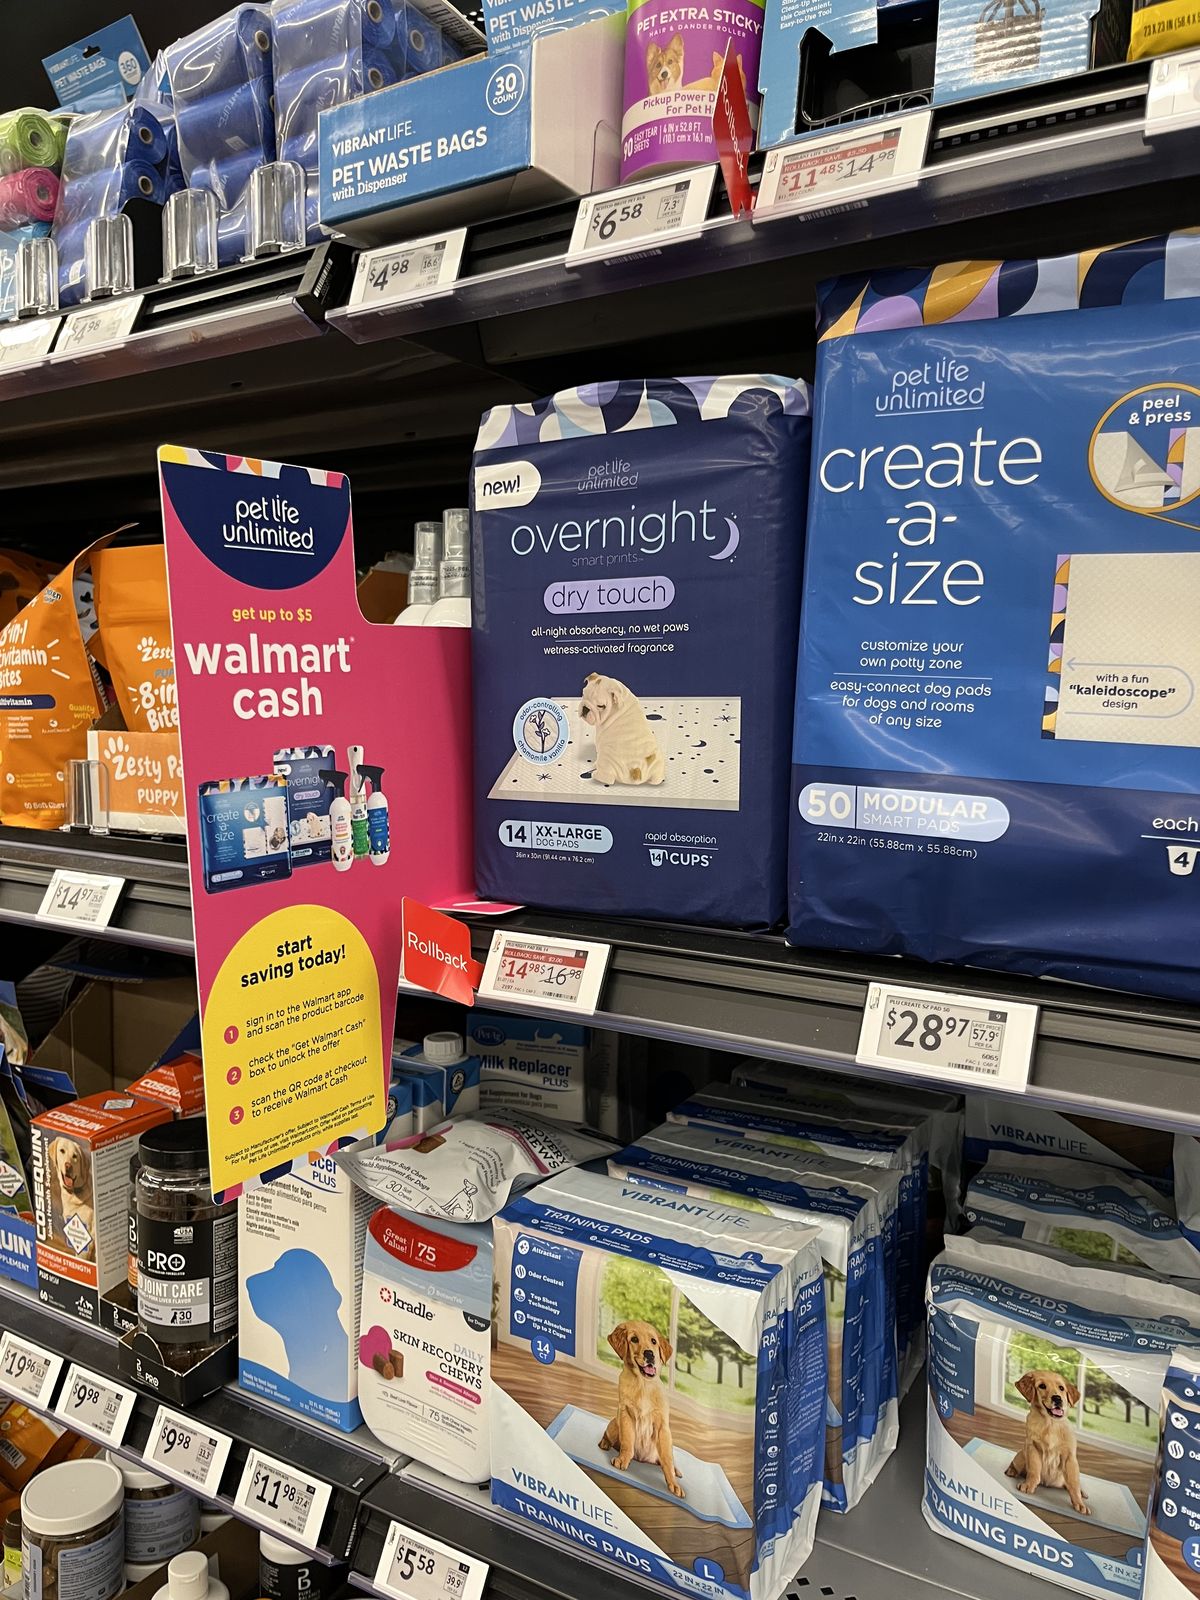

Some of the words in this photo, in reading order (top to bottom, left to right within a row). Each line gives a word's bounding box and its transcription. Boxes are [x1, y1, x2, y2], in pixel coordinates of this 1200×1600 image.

[490, 10, 517, 33] PET
[520, 0, 574, 22] WASTE
[637, 14, 658, 36] PET
[660, 7, 709, 24] EXTRA
[713, 8, 761, 34] STICKY
[819, 8, 832, 18] Tool
[491, 31, 511, 45] with
[649, 27, 666, 37] HAIR
[678, 23, 713, 31] DANDER
[717, 25, 746, 38] ROLLER
[495, 72, 517, 97] 30
[492, 89, 518, 106] COUNT
[643, 95, 672, 110] Pickup
[674, 92, 705, 103] Power
[667, 105, 683, 115] For
[685, 104, 702, 115] Pet
[634, 130, 645, 144] EASY
[645, 126, 658, 139] TEAR
[332, 164, 365, 188] PET
[369, 147, 432, 178] WASTE
[437, 126, 488, 159] BAGS
[332, 188, 355, 203] with
[357, 171, 408, 196] Dispenser
[892, 363, 931, 392] pet
[935, 356, 970, 382] life
[875, 382, 986, 412] unlimited
[1142, 395, 1181, 412] peel
[1128, 412, 1141, 426] &
[1144, 409, 1192, 427] press
[588, 460, 610, 480] pet
[612, 457, 631, 476] life
[819, 427, 1043, 493] create
[482, 475, 521, 496] new!
[577, 472, 639, 491] unlimited
[236, 496, 269, 522] pet
[272, 494, 300, 524] life
[511, 499, 717, 555] overnight
[885, 501, 958, 546] -a-
[222, 523, 314, 550] unlimited
[852, 551, 985, 606] size
[552, 585, 589, 611] dry
[598, 579, 666, 606] touch
[232, 608, 256, 624] get
[259, 609, 277, 623] up
[279, 608, 293, 621] to
[297, 607, 313, 623] $5
[531, 627, 568, 639] all-night
[569, 625, 626, 638] absorbency,
[628, 625, 640, 634] no
[643, 623, 661, 633] wet
[663, 622, 689, 633] paws
[183, 633, 351, 676] walmart
[543, 643, 625, 655] wetness-activated
[627, 642, 674, 654] fragrance
[861, 639, 929, 653] customize
[932, 641, 964, 655] your
[859, 657, 887, 670] own
[890, 656, 925, 672] potty
[928, 658, 963, 671] zone
[232, 677, 323, 720] cash
[830, 680, 920, 696] easy-connect
[923, 681, 952, 699] dog
[955, 683, 992, 699] pads
[69, 703, 95, 714] Quality
[842, 696, 860, 709] for
[863, 697, 898, 712] dogs
[900, 697, 927, 711] and
[930, 700, 975, 714] rooms
[868, 714, 883, 727] of
[885, 715, 912, 731] any
[915, 715, 943, 729] size
[112, 754, 162, 784] Zesty
[137, 787, 179, 807] PUPPY
[806, 789, 852, 819] 50
[863, 792, 988, 821] MODULAR
[862, 812, 912, 830] SMART
[916, 816, 961, 833] PADS
[505, 824, 527, 844] 14
[535, 825, 602, 841] XX-LARGE
[536, 838, 554, 848] DOG
[556, 839, 580, 850] PADS
[645, 831, 668, 843] rapid
[669, 832, 717, 845] absorption
[652, 853, 662, 863] 14
[276, 935, 313, 958] start
[407, 930, 469, 973] Rollback
[240, 960, 294, 988] saving
[298, 944, 347, 973] today!
[246, 1015, 265, 1028] sign
[266, 1012, 275, 1021] in
[276, 1008, 285, 1018] to
[287, 1003, 301, 1014] the
[302, 991, 335, 1009] Walmart
[337, 988, 352, 1000] app
[246, 1026, 263, 1038] and
[265, 1019, 285, 1033] scan
[287, 1013, 300, 1025] the
[302, 1004, 333, 1021] product
[334, 992, 365, 1009] barcode
[508, 1055, 572, 1077] Replacer
[542, 1076, 569, 1089] PLUS
[31, 1127, 48, 1242] COSEQUIN
[385, 1227, 408, 1245] Great
[543, 1208, 609, 1234] TRAINING
[611, 1226, 654, 1246] PADS
[383, 1234, 408, 1254] Value!
[417, 1242, 437, 1262] 75
[532, 1246, 562, 1261] Attractant
[144, 1278, 169, 1298] JOINT
[171, 1281, 204, 1298] CARE
[528, 1270, 542, 1281] Odor
[542, 1275, 564, 1288] Control
[393, 1289, 434, 1322] kradle
[393, 1328, 420, 1349] SKIN
[422, 1341, 485, 1378] RECOVERY
[536, 1340, 550, 1355] 14
[439, 1361, 483, 1391] CHEWS
[515, 1496, 598, 1549] TRAINING
[602, 1542, 652, 1573] PADS
